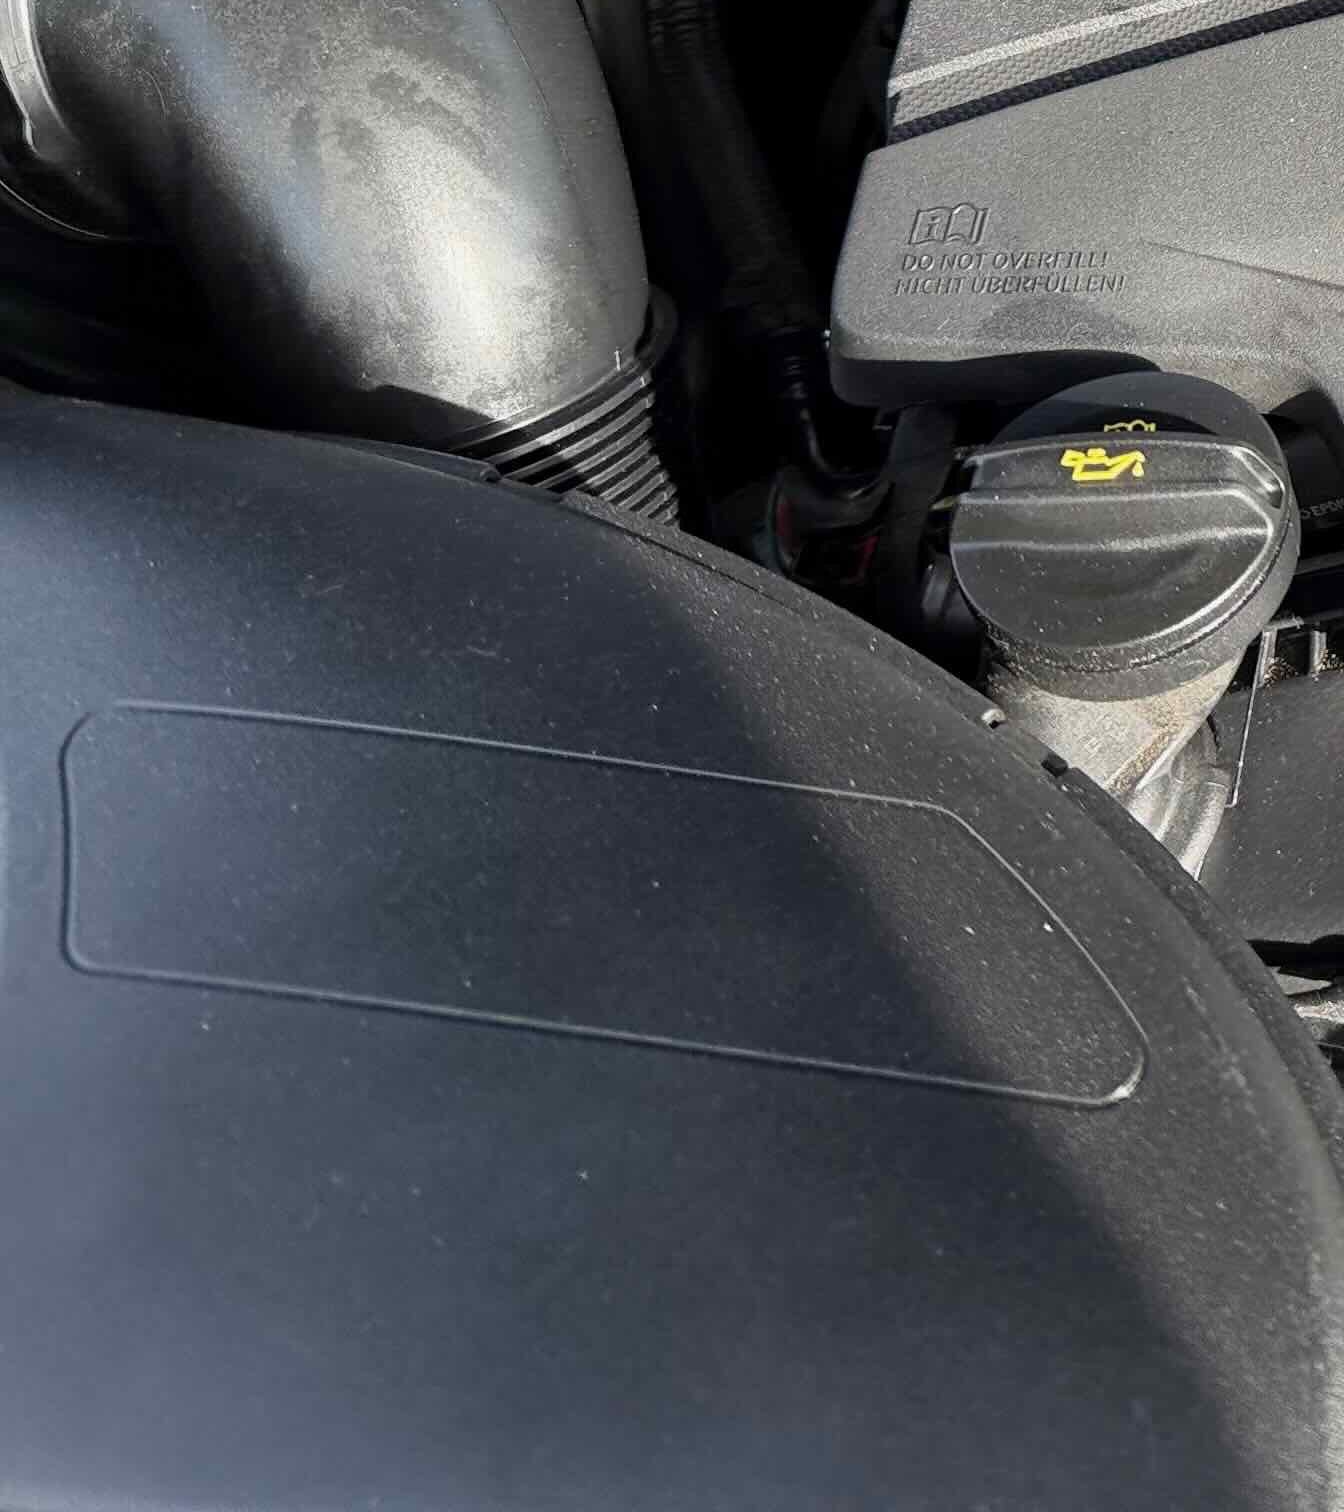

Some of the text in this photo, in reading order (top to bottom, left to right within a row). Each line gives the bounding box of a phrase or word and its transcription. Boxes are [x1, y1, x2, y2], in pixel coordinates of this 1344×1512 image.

[902, 250, 1109, 272] DO NOT OVERFILL!
[894, 275, 966, 296] NICHT
